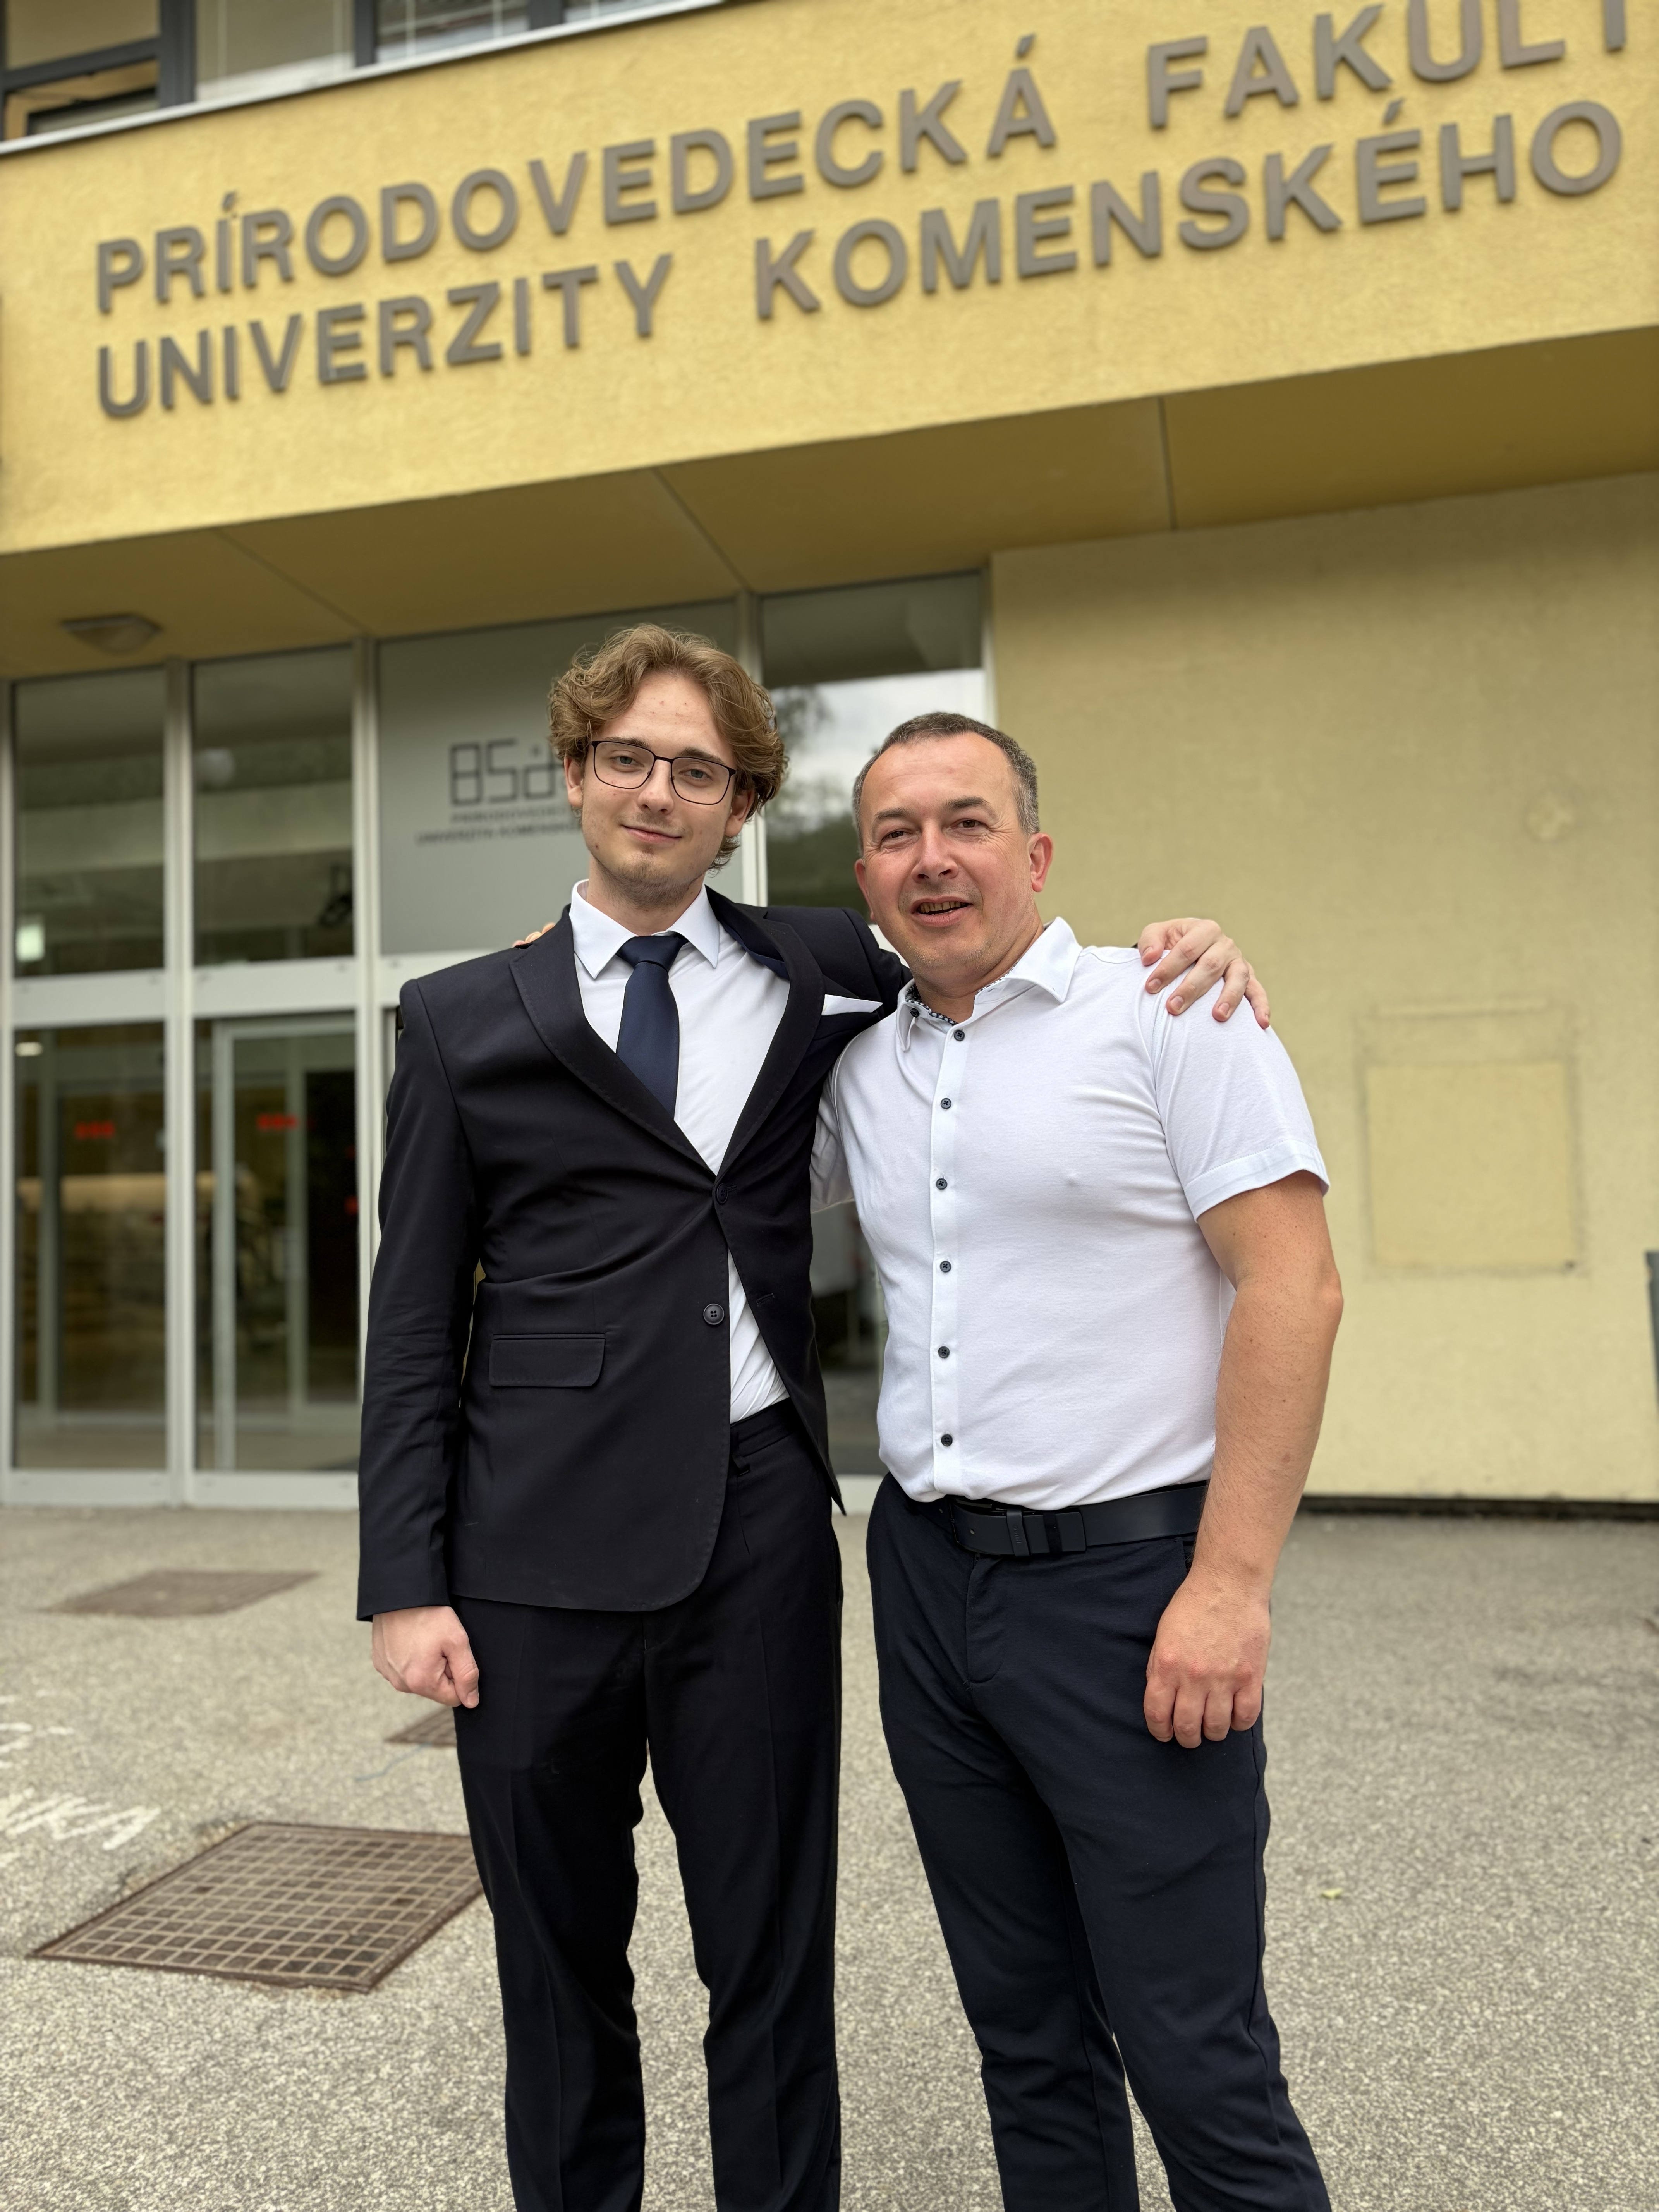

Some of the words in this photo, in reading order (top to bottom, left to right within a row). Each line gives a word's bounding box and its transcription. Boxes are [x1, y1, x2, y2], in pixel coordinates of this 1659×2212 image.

[96, 33, 1056, 313] PRÍRODOVEDECKÁ
[98, 254, 672, 419] UNIVERZITY
[754, 98, 1623, 319] KOMENSKÉHO
